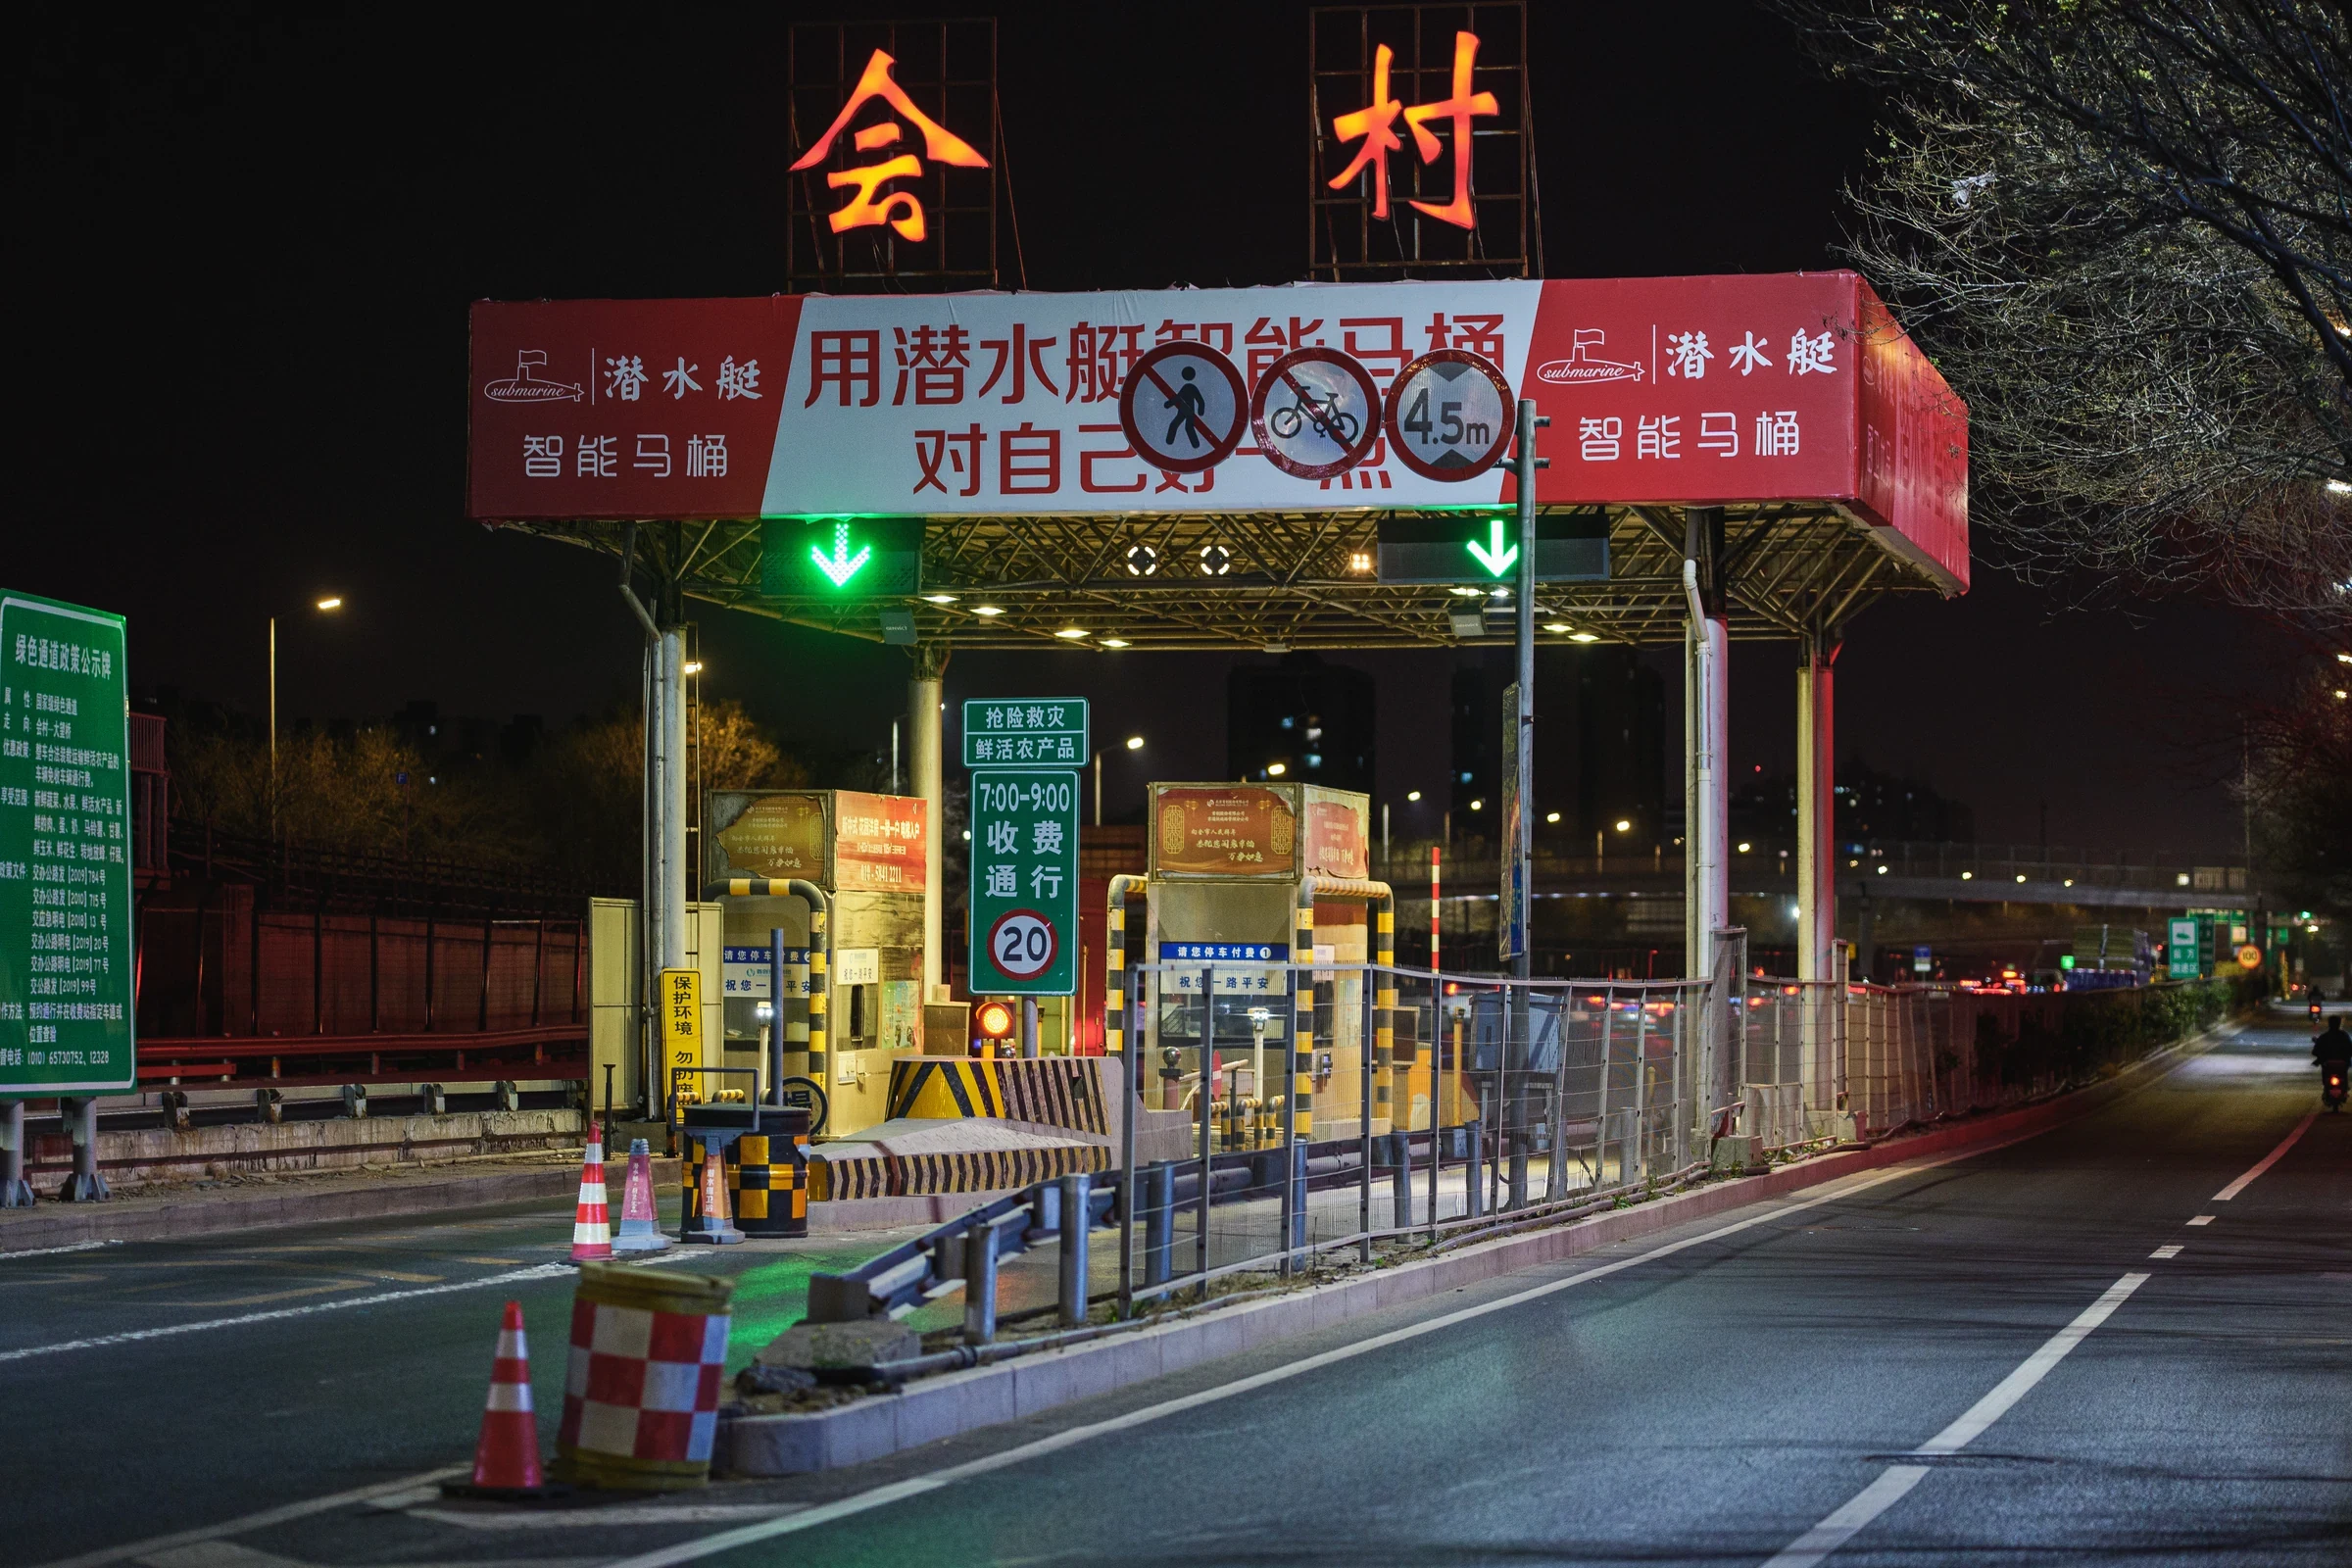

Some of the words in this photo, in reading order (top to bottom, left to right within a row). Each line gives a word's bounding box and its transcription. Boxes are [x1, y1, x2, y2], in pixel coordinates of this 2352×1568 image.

[1665, 327, 1838, 380] 潜水艇
[604, 355, 762, 401] 潜水艇
[1544, 362, 1625, 380] submarine
[490, 382, 565, 398] submarine
[1403, 387, 1490, 446] 4.5m
[1579, 410, 1800, 462] 智能马桶
[523, 433, 728, 477] 智能马桶
[15, 633, 112, 680] 绿色通道政策公示牌
[36, 693, 78, 716] 国家级绿色通道
[986, 706, 1065, 729] 抢险救灾
[975, 737, 1075, 760] 鲜活农产品
[980, 783, 1070, 812] 7:00-9:00
[987, 820, 1063, 856] 收费
[985, 864, 1063, 899] 通行
[724, 950, 799, 962] 请您停车费
[1003, 926, 1048, 962] 20
[2242, 951, 2257, 960] 100
[725, 979, 810, 993] 祝您一平安
[1179, 976, 1269, 989] 祝您一路平安
[672, 976, 693, 1036] 保护环境
